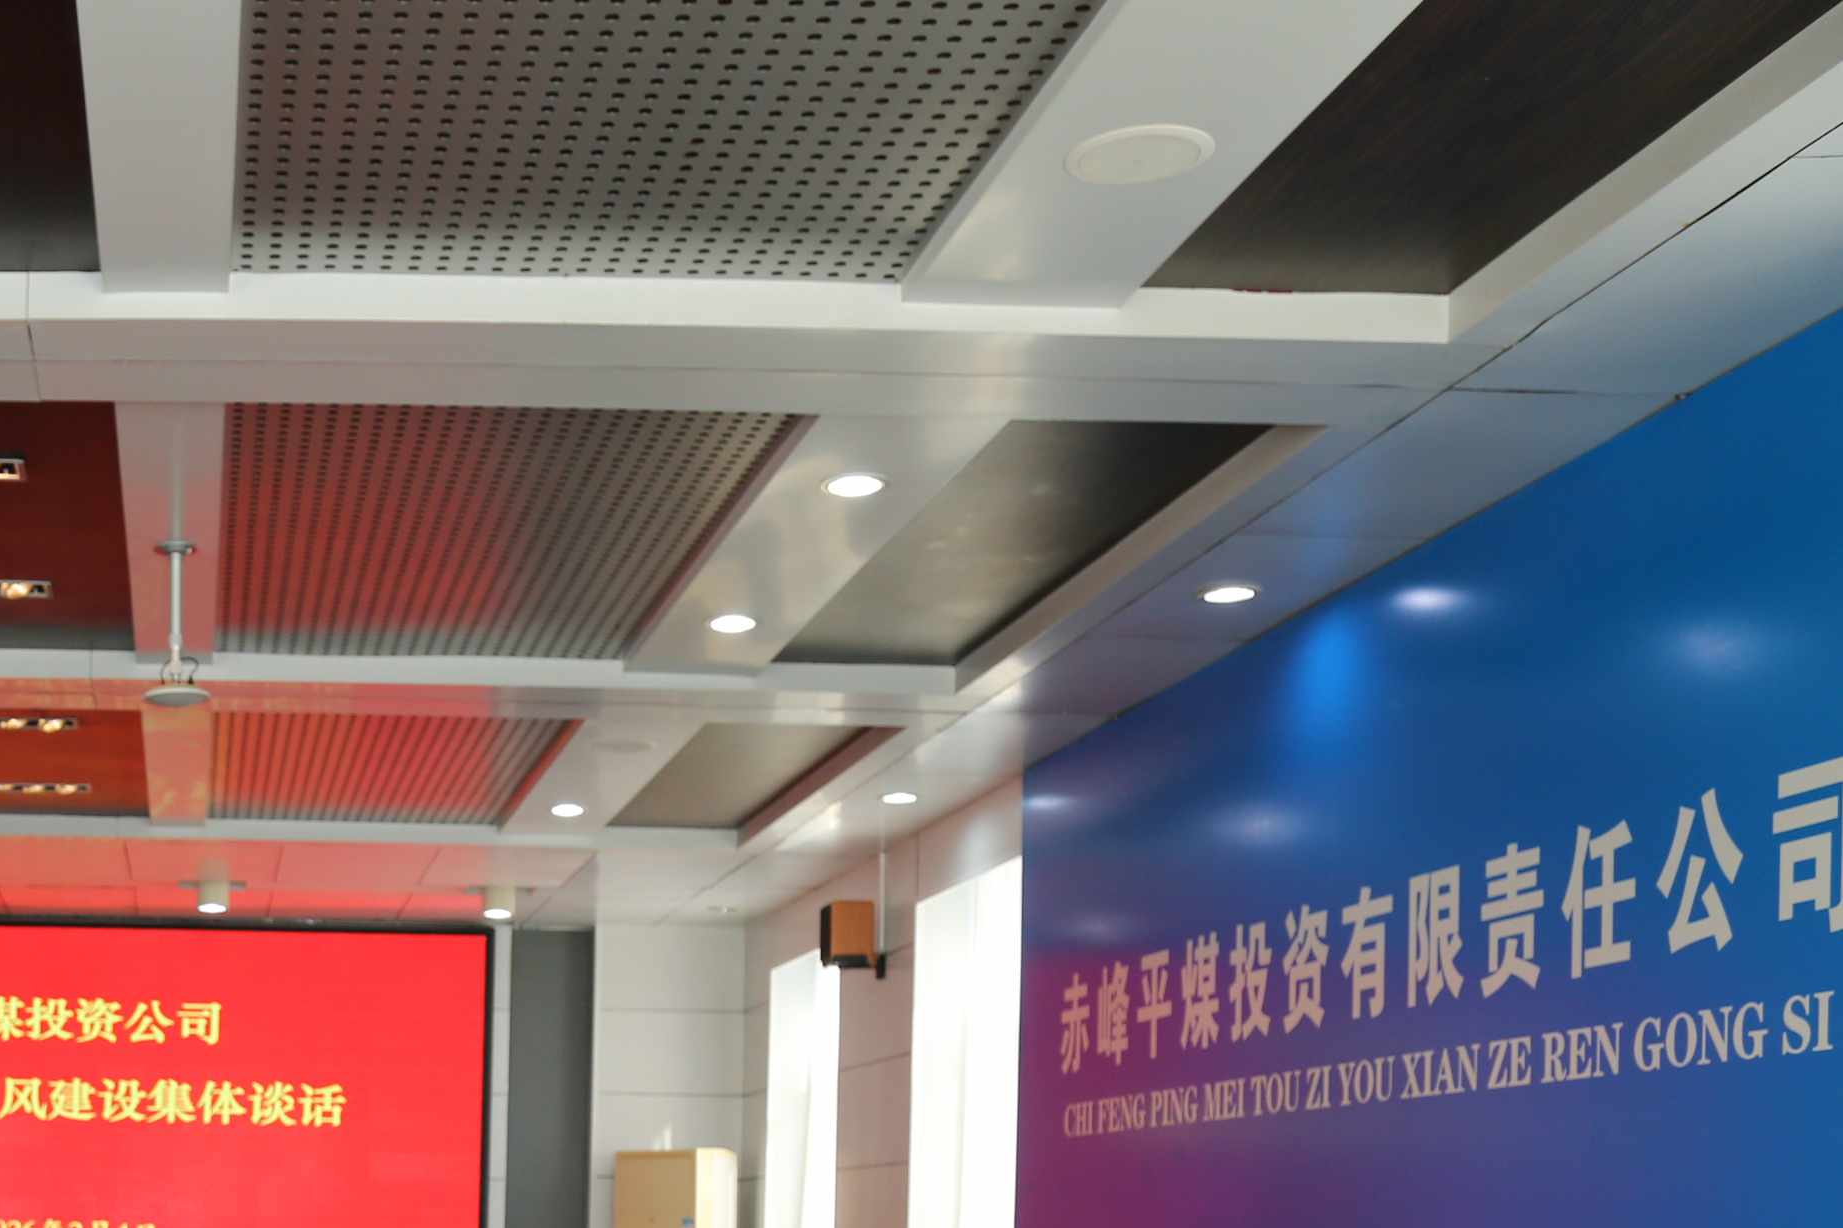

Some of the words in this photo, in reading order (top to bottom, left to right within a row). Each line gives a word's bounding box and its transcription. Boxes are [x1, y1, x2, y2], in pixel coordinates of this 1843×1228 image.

[1061, 756, 1843, 1074] 赤峰平煤投资有限责任公司
[1063, 1100, 1094, 1137] CHI
[1098, 1094, 1147, 1135] FENG
[1151, 1086, 1198, 1128] PING
[1202, 1078, 1246, 1122] MEI
[1249, 1070, 1301, 1117] TOU
[1306, 1064, 1332, 1111] ZI
[1337, 1056, 1396, 1106] YOU
[1400, 1042, 1481, 1099] XIAN
[1487, 1035, 1533, 1090] ZE
[1541, 1021, 1624, 1084] REN
[1633, 1000, 1769, 1073] GONG
[1781, 990, 1835, 1056] SI
